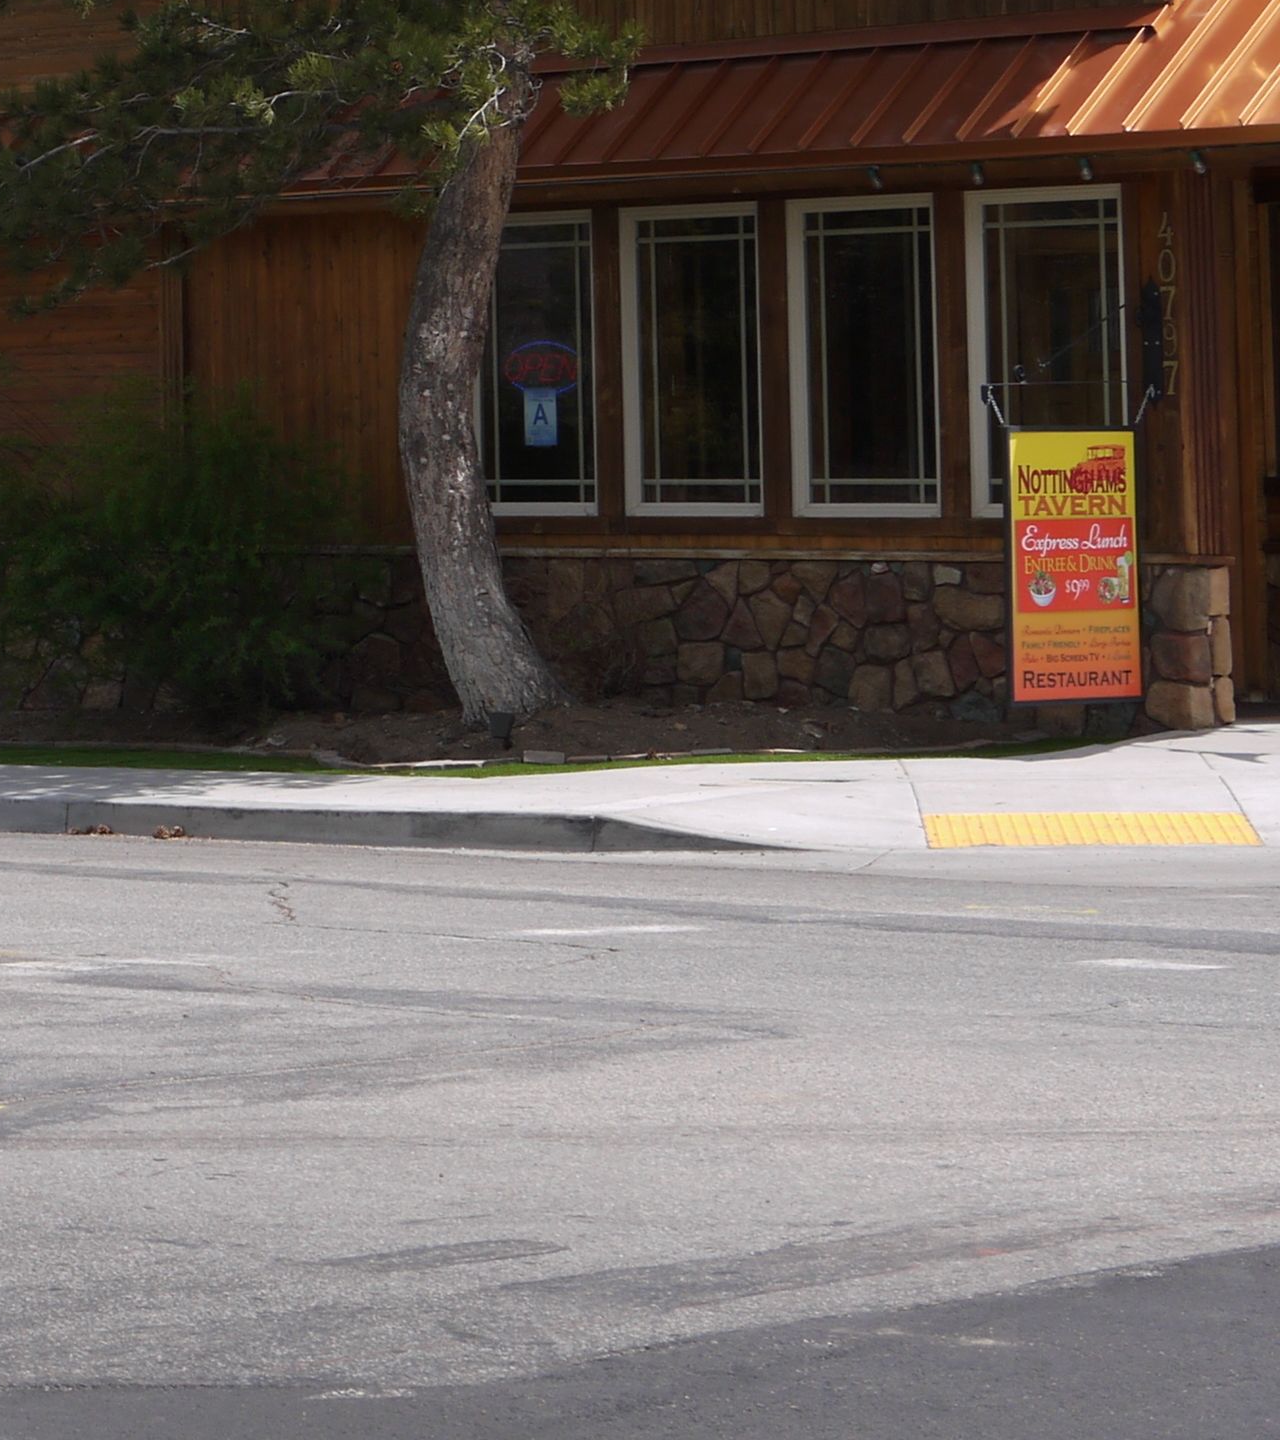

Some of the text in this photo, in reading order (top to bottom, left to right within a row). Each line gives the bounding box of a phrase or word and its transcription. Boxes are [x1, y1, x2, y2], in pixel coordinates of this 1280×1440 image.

[504, 353, 579, 382] OPEN
[533, 402, 548, 425] A
[1018, 464, 1127, 494] NOTTINGHAMS
[1018, 494, 1127, 516] TAVERN
[1022, 523, 1128, 557] Express Lunch
[1079, 553, 1117, 573] DRINK
[1047, 640, 1080, 648] FRIENDLY
[1089, 652, 1100, 661] TV
[1023, 669, 1133, 689] RESTAURANT
